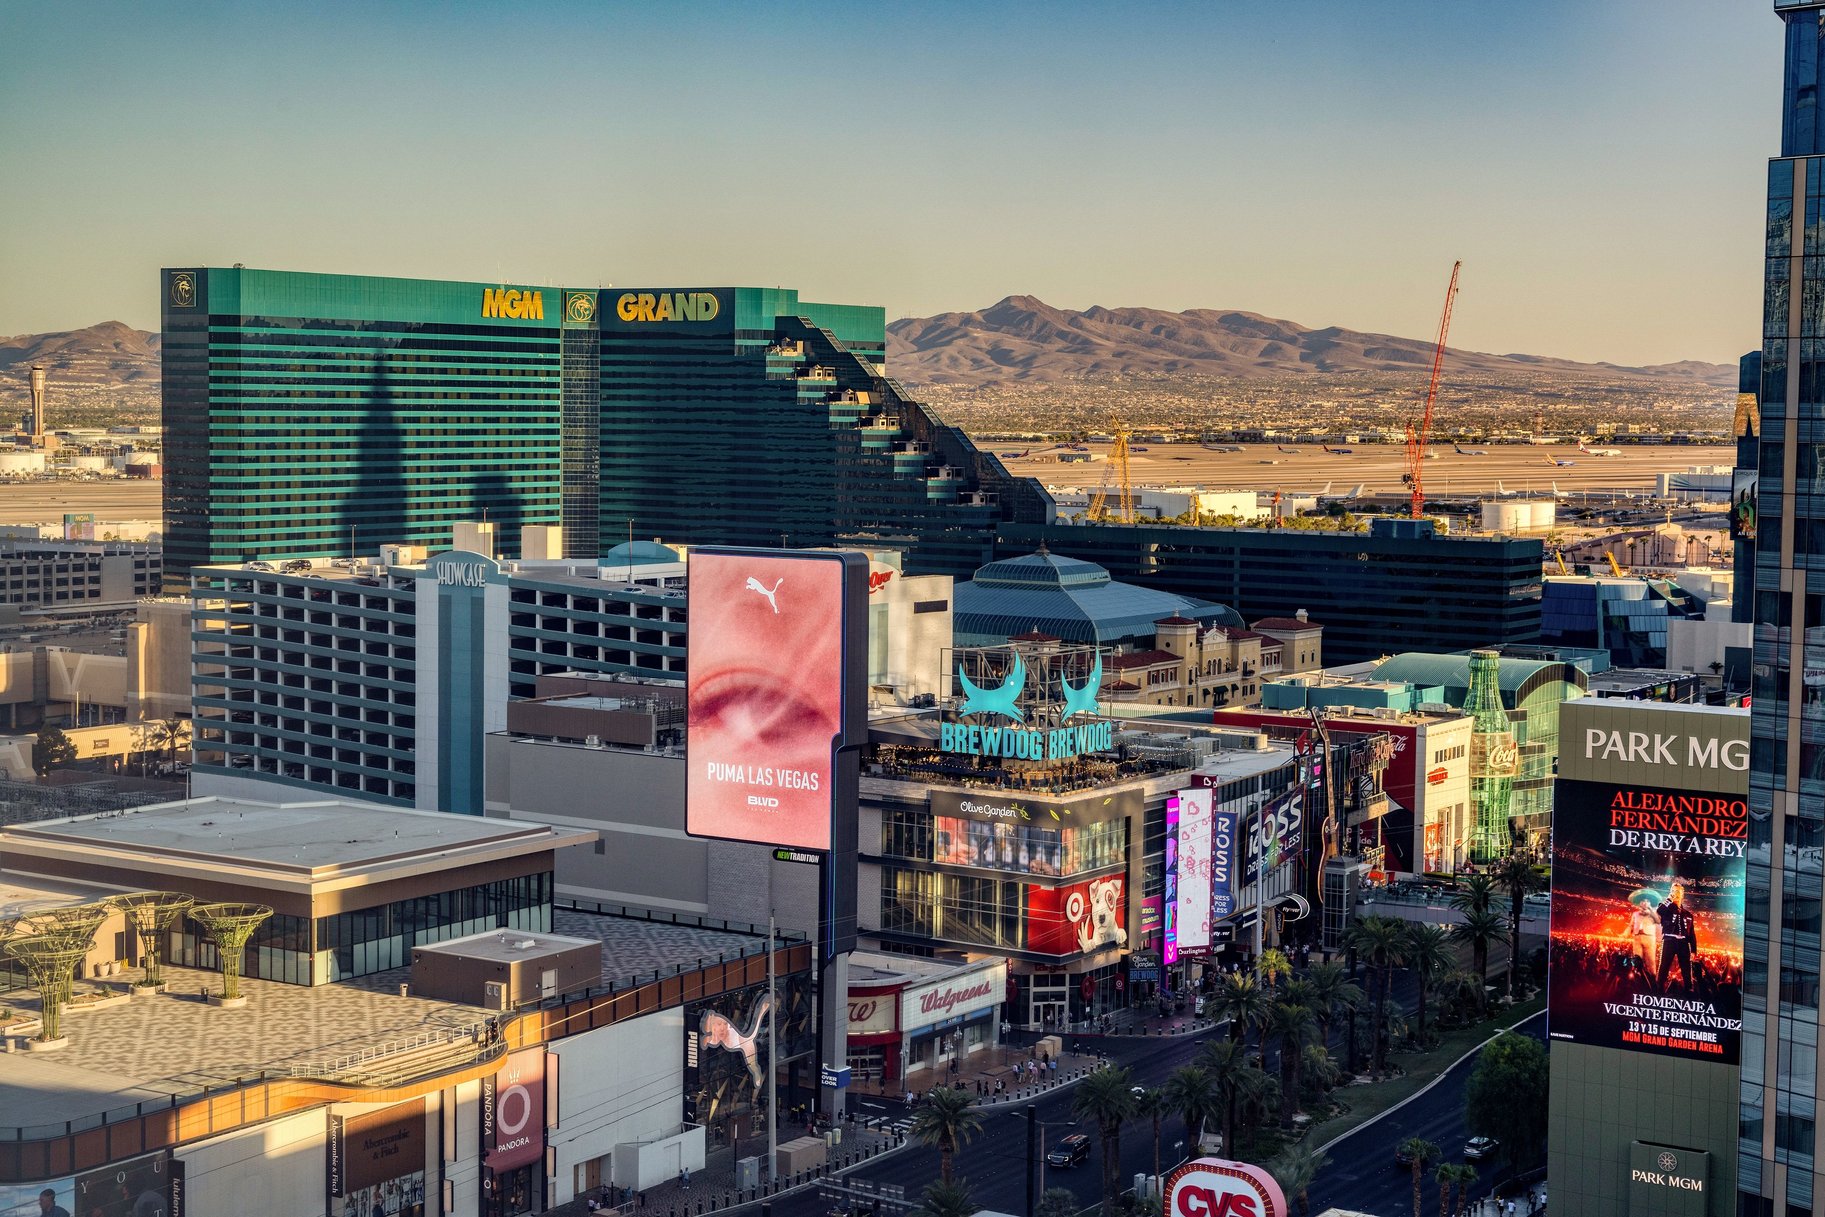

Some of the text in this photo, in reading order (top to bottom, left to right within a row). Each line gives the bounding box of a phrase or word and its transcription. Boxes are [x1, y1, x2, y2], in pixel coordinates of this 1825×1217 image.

[481, 288, 719, 322] MGM GRAND
[436, 561, 486, 587] SHOWCASE
[940, 720, 1112, 761] BREWDOG BREWDOG
[1585, 728, 1749, 771] PARK MG
[707, 762, 819, 791] PUMA LAS VEGAS
[747, 795, 779, 808] BLVD
[960, 801, 1017, 818] Olive Garden
[1610, 790, 1747, 819] ALEJANDRO
[1248, 794, 1303, 858] ROSS
[1609, 809, 1748, 839] FERNÁNDEZ
[1214, 817, 1232, 883] ROSS
[1284, 832, 1301, 850] LESS
[1609, 829, 1747, 858] DE REY A REY
[1214, 894, 1230, 902] RESS
[1129, 969, 1159, 980] BREWDOG
[920, 980, 992, 1014] Walgreens
[1632, 993, 1717, 1015] HOMENAJE A
[1603, 1002, 1742, 1031] VICENTE FERNÁNDEZ
[1622, 1030, 1723, 1054] MGM GRAND GARDEN ARENA
[1628, 1021, 1717, 1043] 13 Y 15 DE SEPTIEMBRE
[687, 1030, 698, 1068] PUMA
[821, 1074, 837, 1082] OVER
[821, 1079, 837, 1087] LOOK
[498, 1136, 530, 1153] PANDORA
[1631, 1169, 1703, 1192] PARK MGM
[1177, 1184, 1257, 1217] CVS
